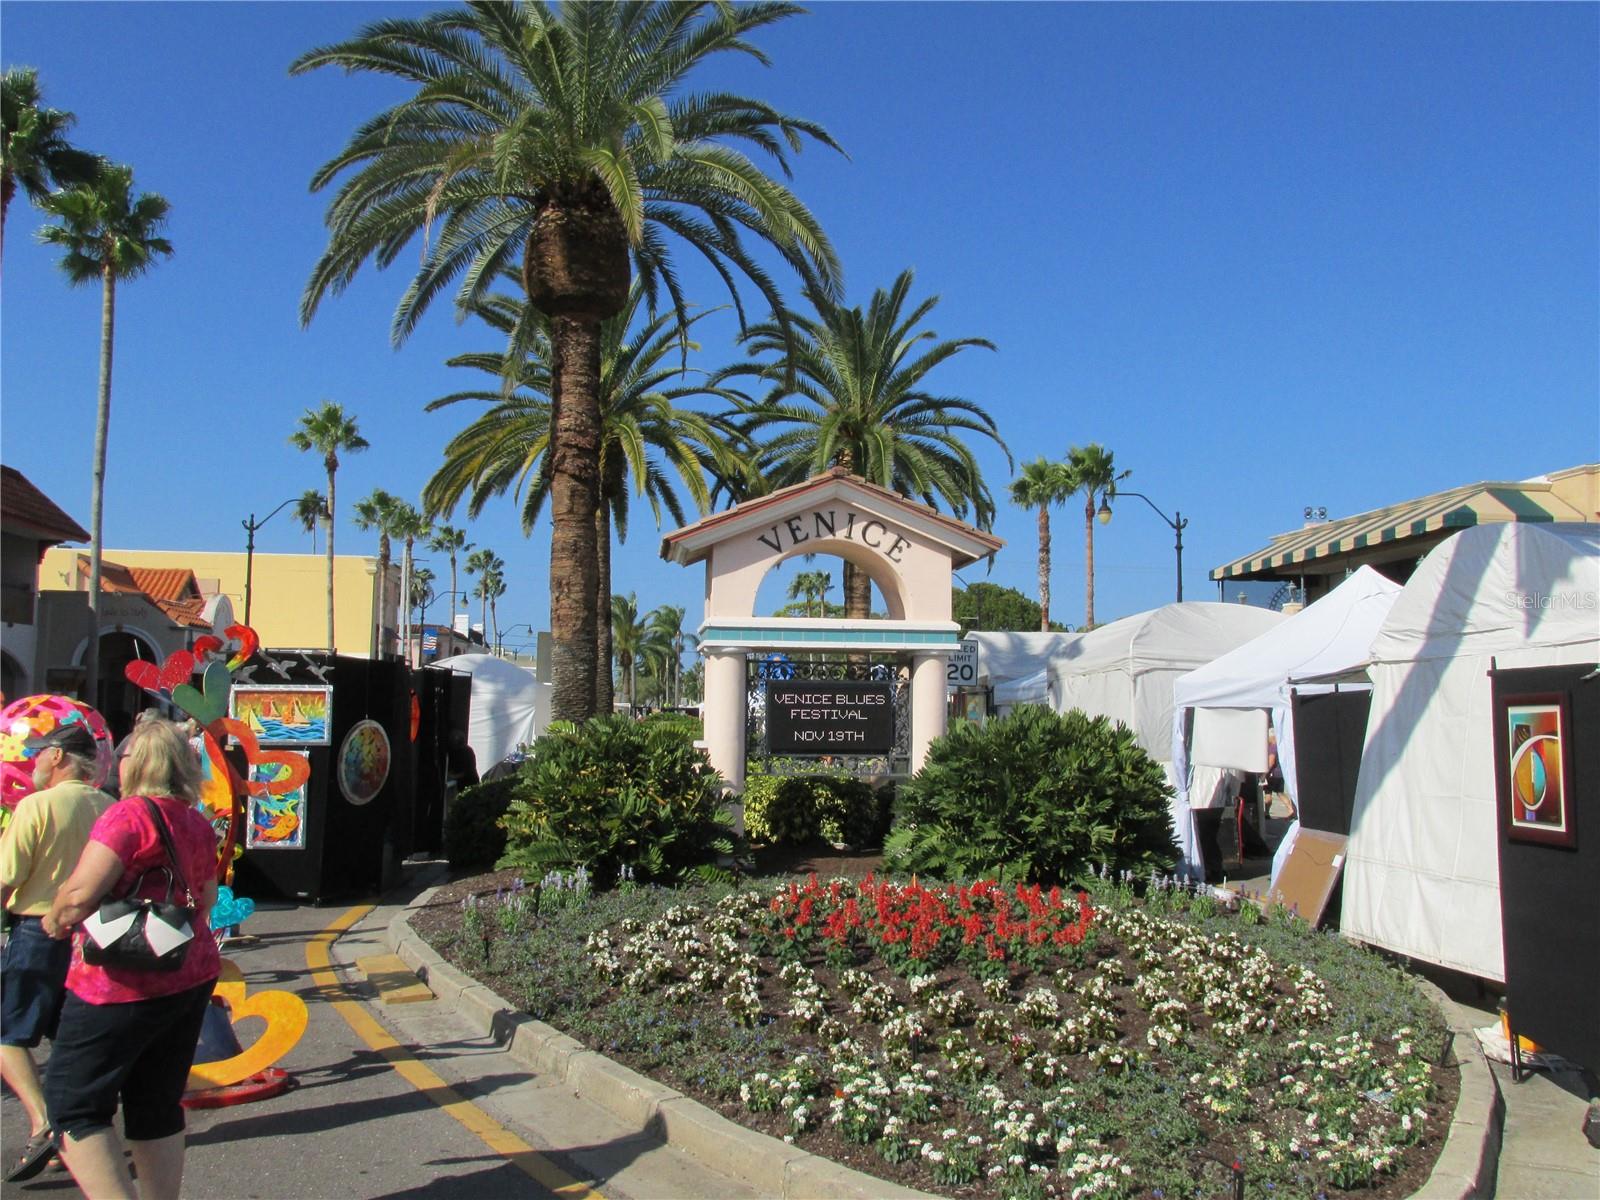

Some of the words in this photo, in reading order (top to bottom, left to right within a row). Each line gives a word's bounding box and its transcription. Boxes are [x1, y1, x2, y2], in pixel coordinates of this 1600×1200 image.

[757, 511, 912, 563] VENICE
[947, 663, 973, 681] 20
[774, 694, 832, 704] VENICE
[836, 694, 886, 705] BLUES
[790, 709, 868, 720] FESTIVAL
[794, 730, 825, 741] NOV
[828, 730, 865, 741] 19TH
